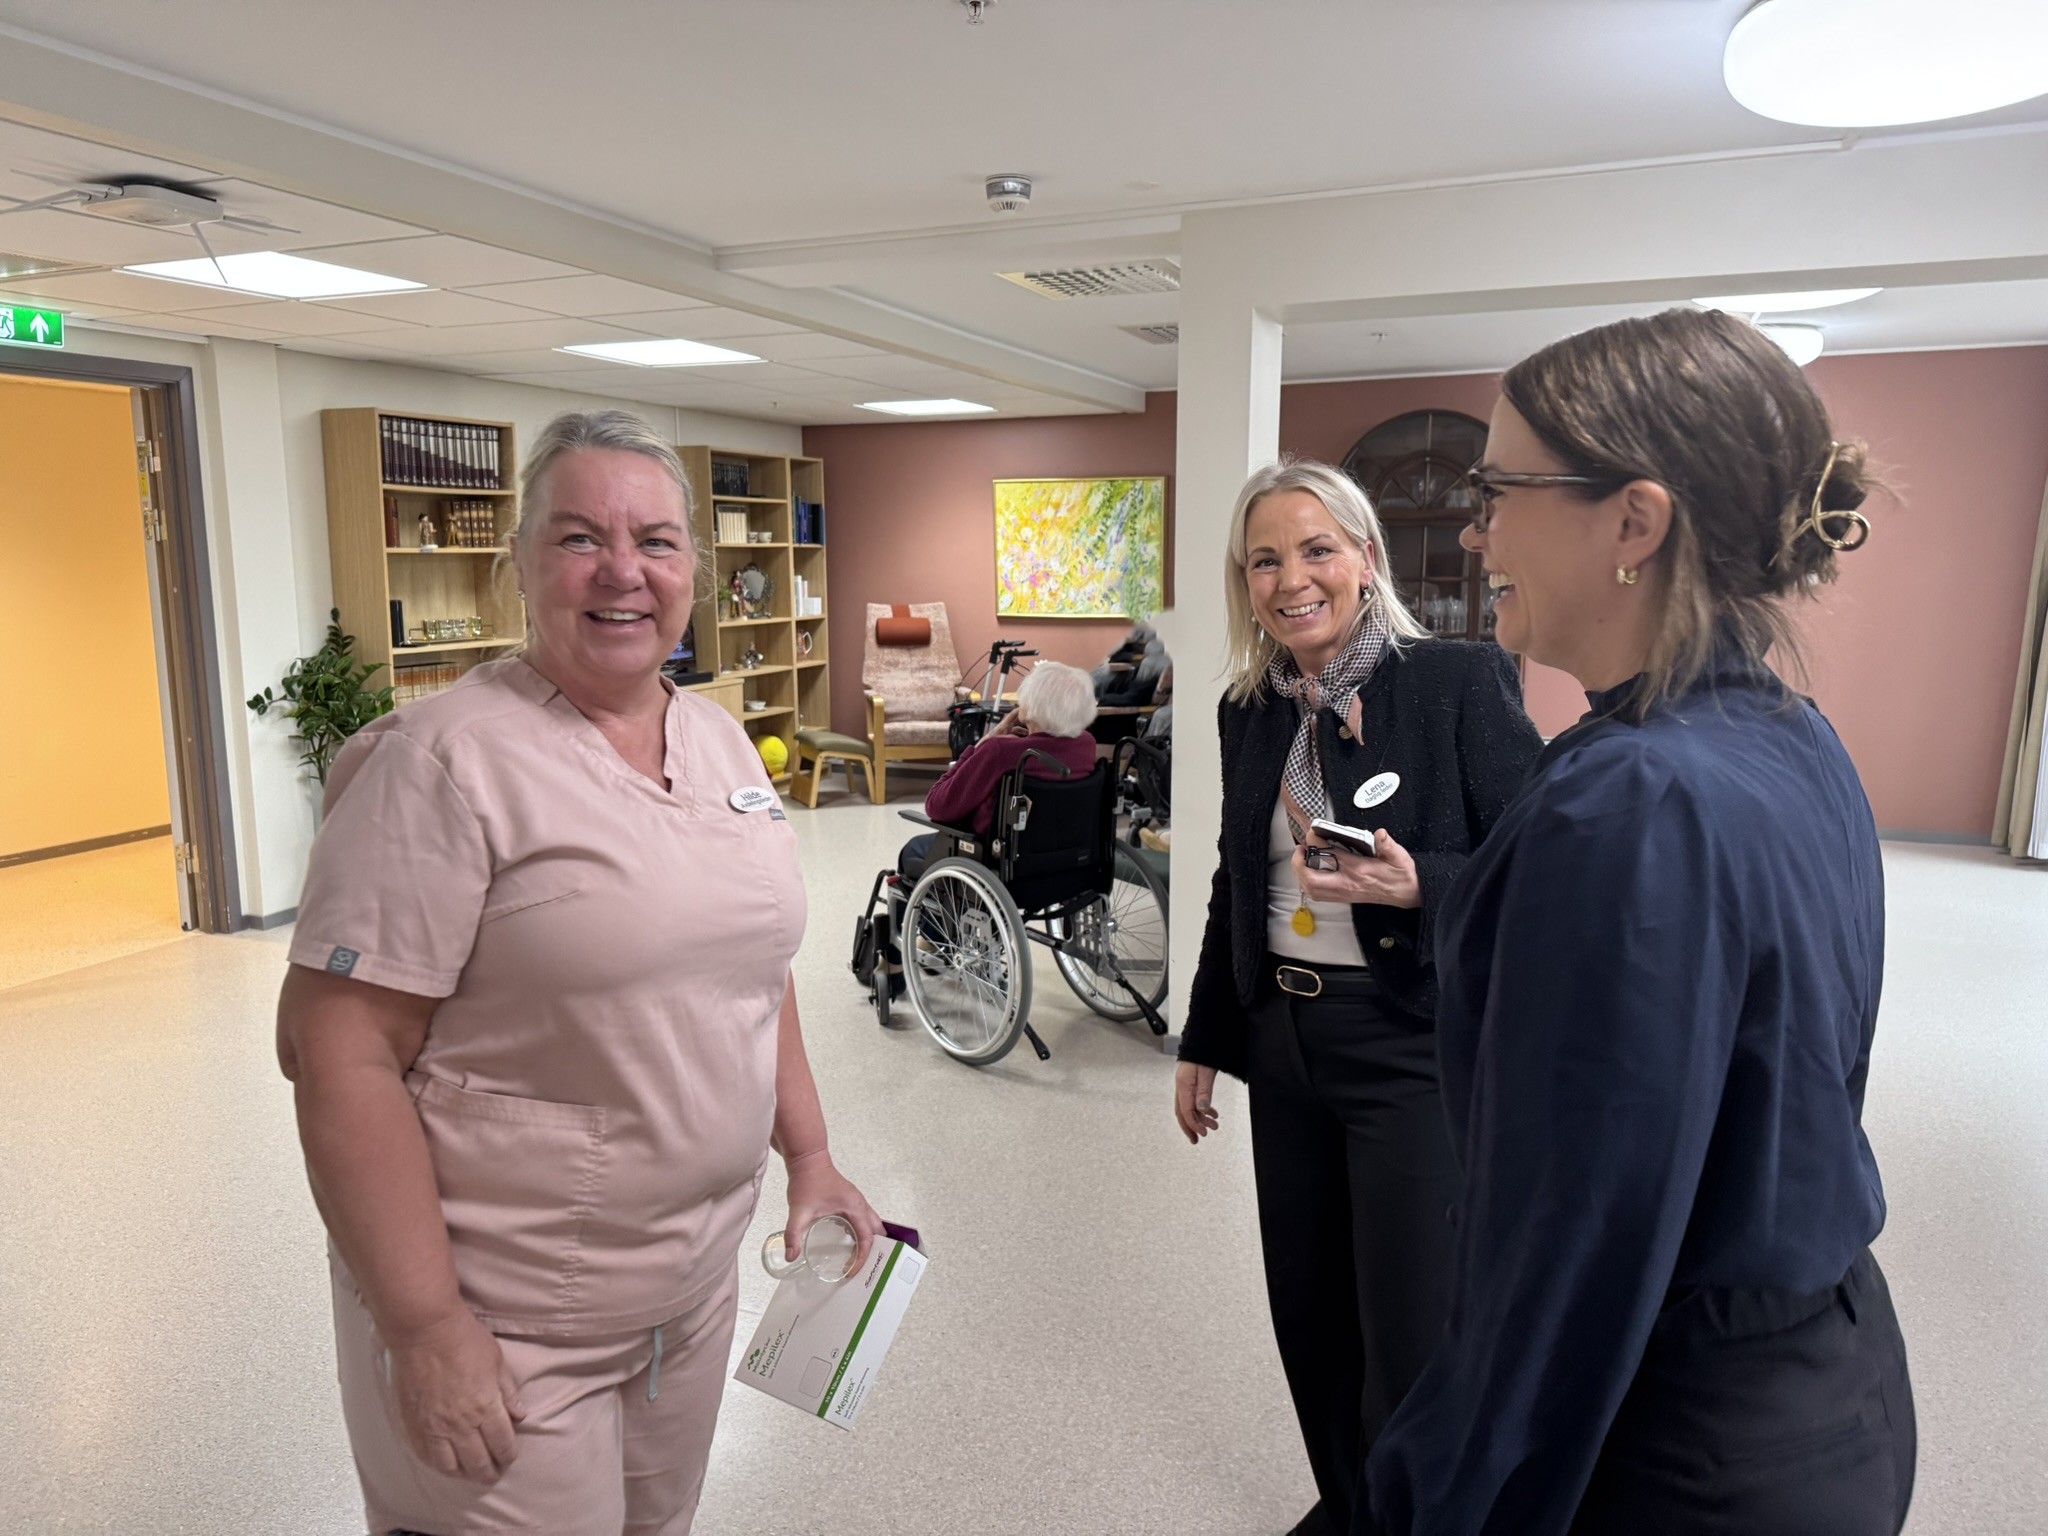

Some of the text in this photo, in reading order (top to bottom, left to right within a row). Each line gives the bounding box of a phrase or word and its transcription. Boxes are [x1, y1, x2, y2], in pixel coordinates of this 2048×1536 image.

[740, 791, 761, 801] Hilde
[1364, 781, 1385, 796] Lena
[759, 1331, 783, 1377] Mepilex
[834, 1380, 854, 1415] Mepilex
